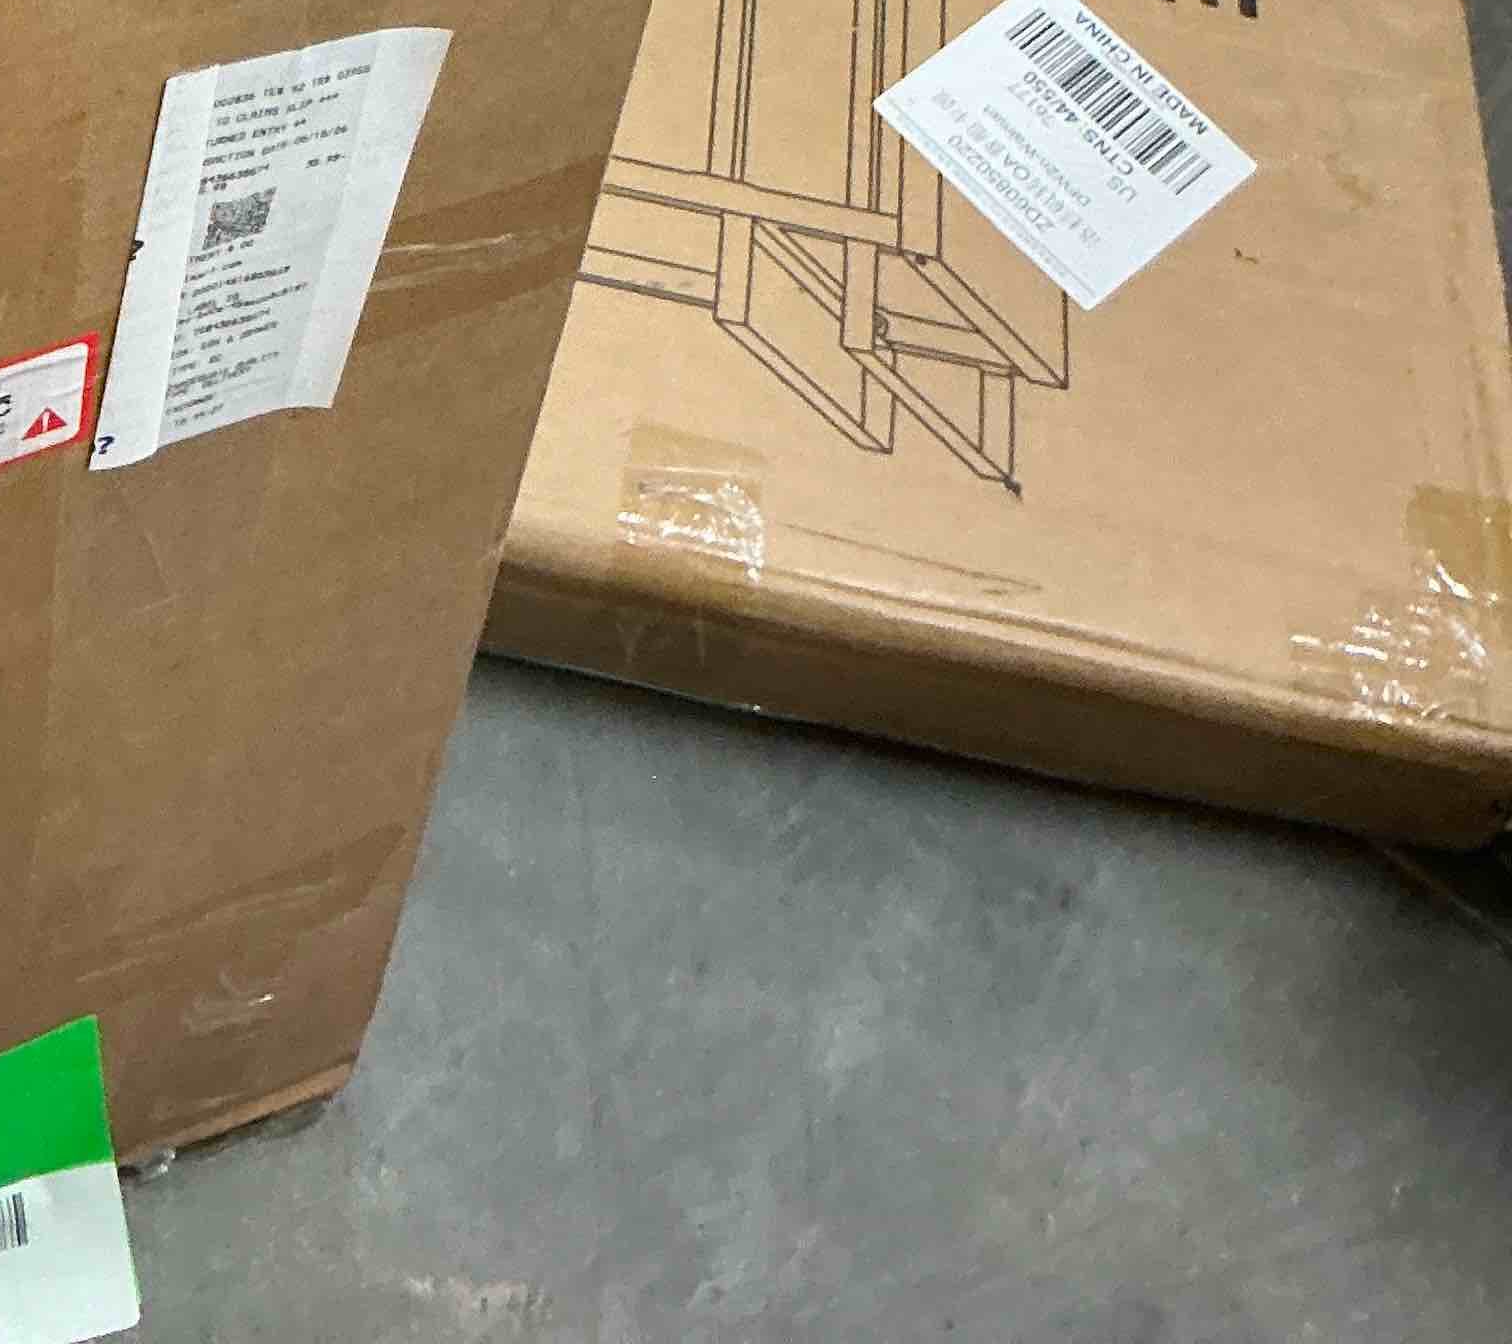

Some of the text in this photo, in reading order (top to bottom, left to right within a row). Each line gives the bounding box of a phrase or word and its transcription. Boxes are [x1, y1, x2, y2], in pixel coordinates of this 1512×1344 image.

[1075, 10, 1131, 63] CHINA
[1133, 63, 1156, 82] IN
[1157, 83, 1208, 135] MADE
